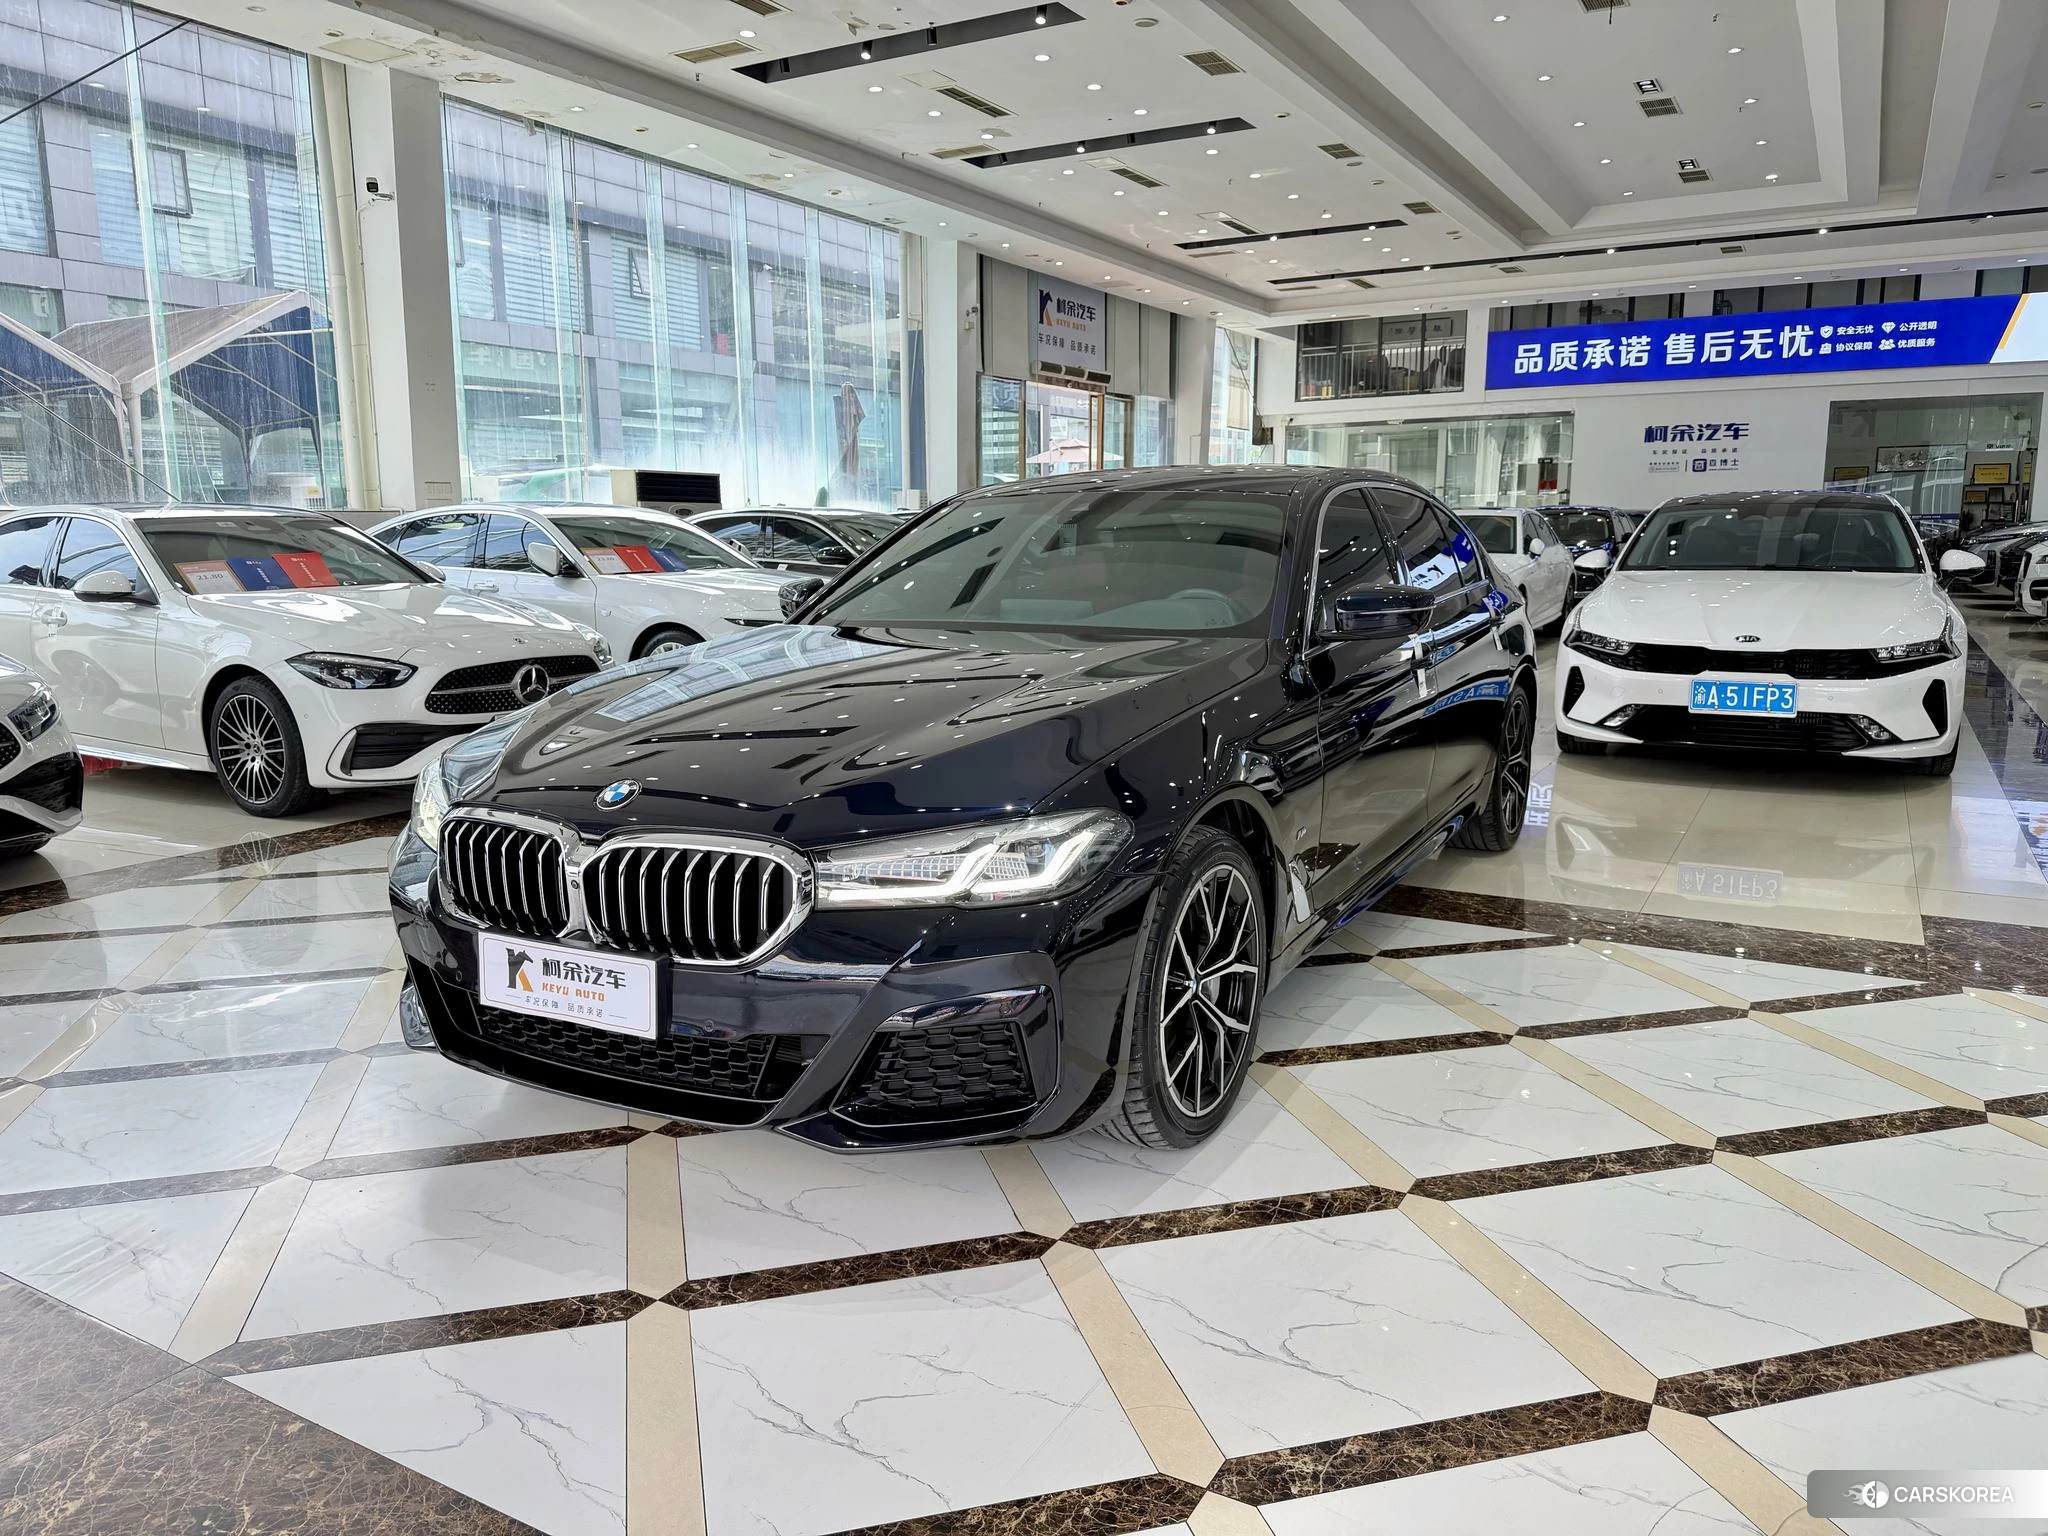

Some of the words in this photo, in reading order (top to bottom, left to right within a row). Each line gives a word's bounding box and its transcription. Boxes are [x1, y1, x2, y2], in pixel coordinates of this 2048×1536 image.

[1836, 324, 1875, 336] 安全无忧
[1899, 320, 1938, 332] 公开透明
[1514, 335, 1652, 374] 品质承诺
[1663, 325, 1814, 365] 售后无忧
[1835, 341, 1873, 352] 协议保障
[1897, 337, 1936, 349] 优质服务
[1644, 423, 1750, 443] 柯余汽车
[541, 957, 627, 990] 柯余汽车
[541, 982, 570, 996] KEYU
[575, 989, 605, 1002] AUTO
[567, 1002, 603, 1018] 品质承诺
